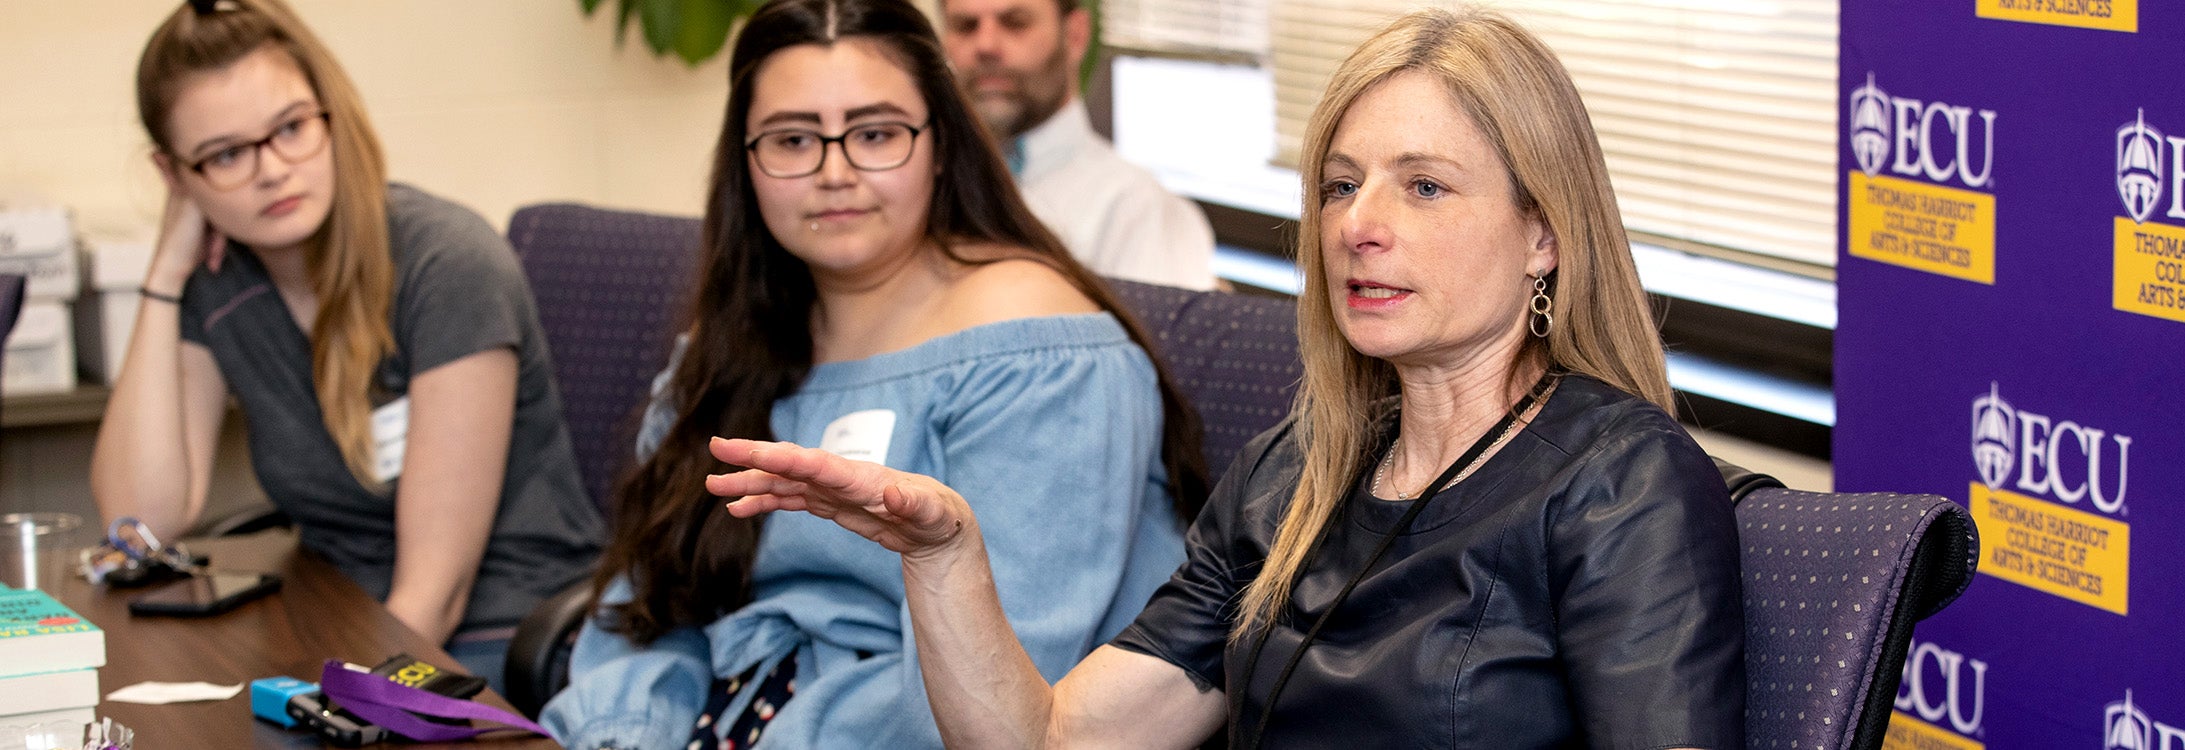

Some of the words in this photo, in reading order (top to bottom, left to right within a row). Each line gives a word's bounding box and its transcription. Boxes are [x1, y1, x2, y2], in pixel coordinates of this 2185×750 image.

[1891, 96, 1997, 187] ECU
[2138, 282, 2174, 308] ARTS
[2016, 409, 2133, 514] ECU
[1987, 497, 2043, 532] THOMAS
